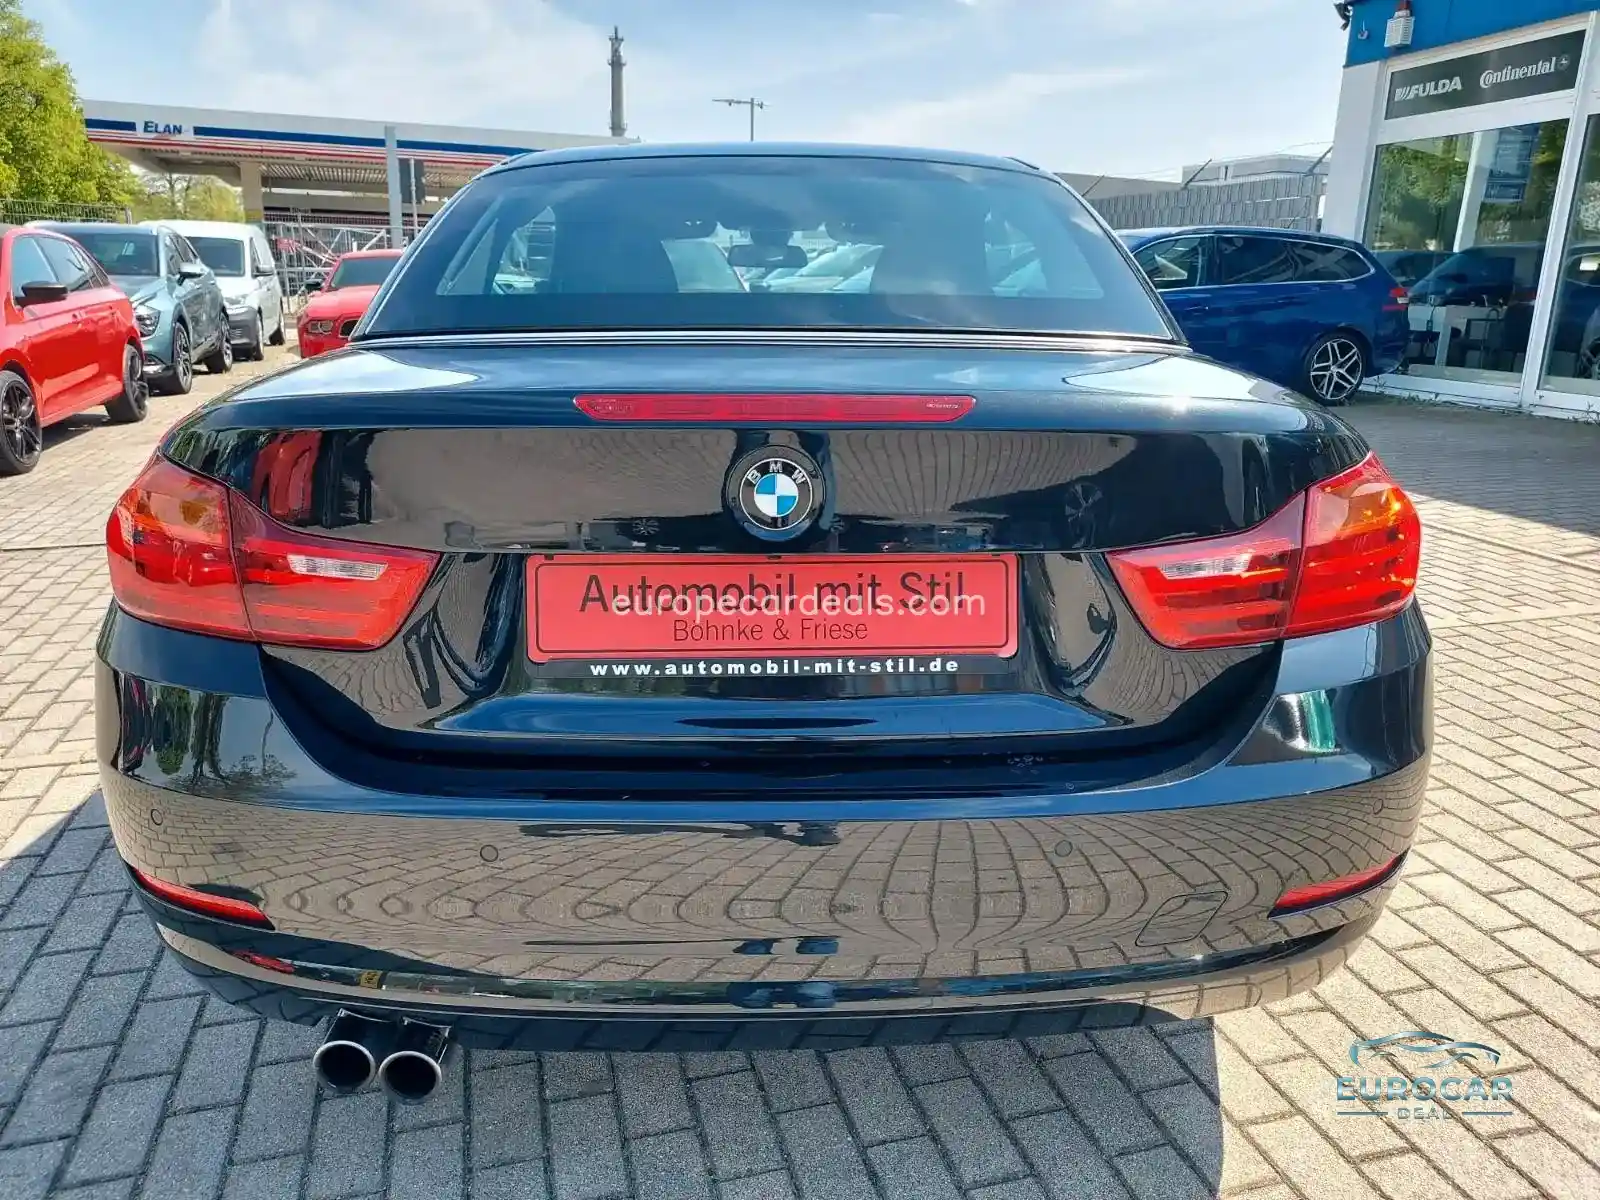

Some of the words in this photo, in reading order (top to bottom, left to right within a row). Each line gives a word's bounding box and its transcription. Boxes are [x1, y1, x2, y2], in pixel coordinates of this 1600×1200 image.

[1480, 56, 1556, 89] Continental
[747, 460, 806, 485] BMW
[579, 573, 796, 613] Automobil
[816, 573, 882, 610] mit
[900, 571, 963, 609] Stil
[673, 619, 763, 642] Böhnke
[773, 619, 790, 641] &
[800, 617, 868, 640] Friese
[590, 657, 960, 676] www.automobil-mit-stil.de
